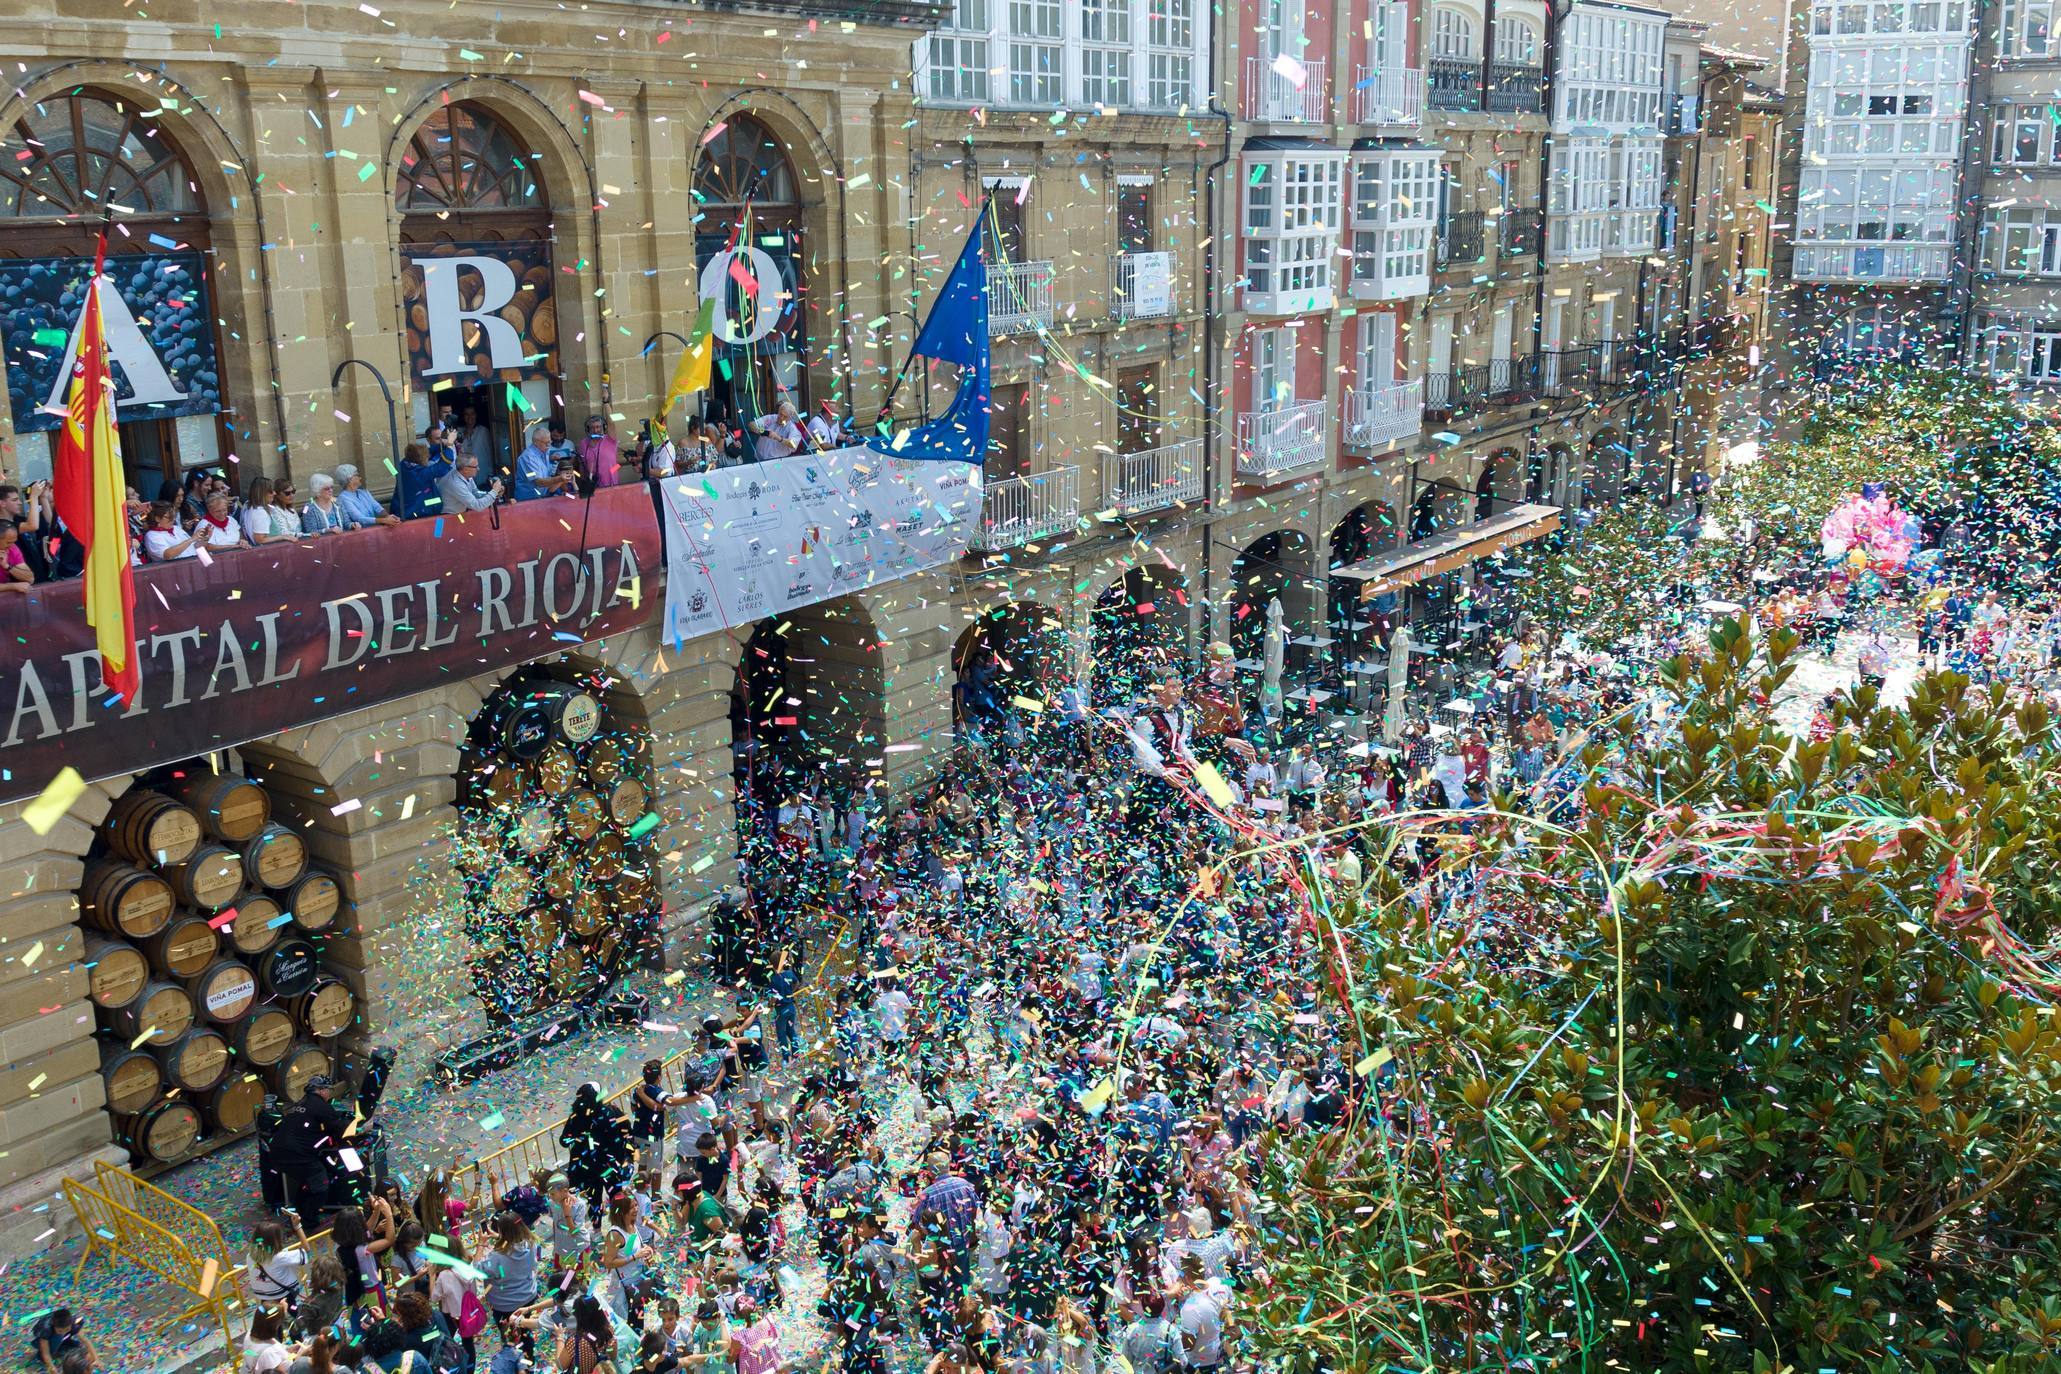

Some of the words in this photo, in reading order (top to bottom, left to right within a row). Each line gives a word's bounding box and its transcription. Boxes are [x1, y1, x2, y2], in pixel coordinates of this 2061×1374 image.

[411, 255, 535, 377] R
[700, 245, 783, 345] O
[895, 521, 924, 534] MASET
[320, 579, 459, 672] DEL
[475, 541, 643, 637] RIOJA
[738, 592, 764, 605] CARLOS
[209, 993, 227, 1004] VIÑA
[228, 984, 252, 997] POMAL
